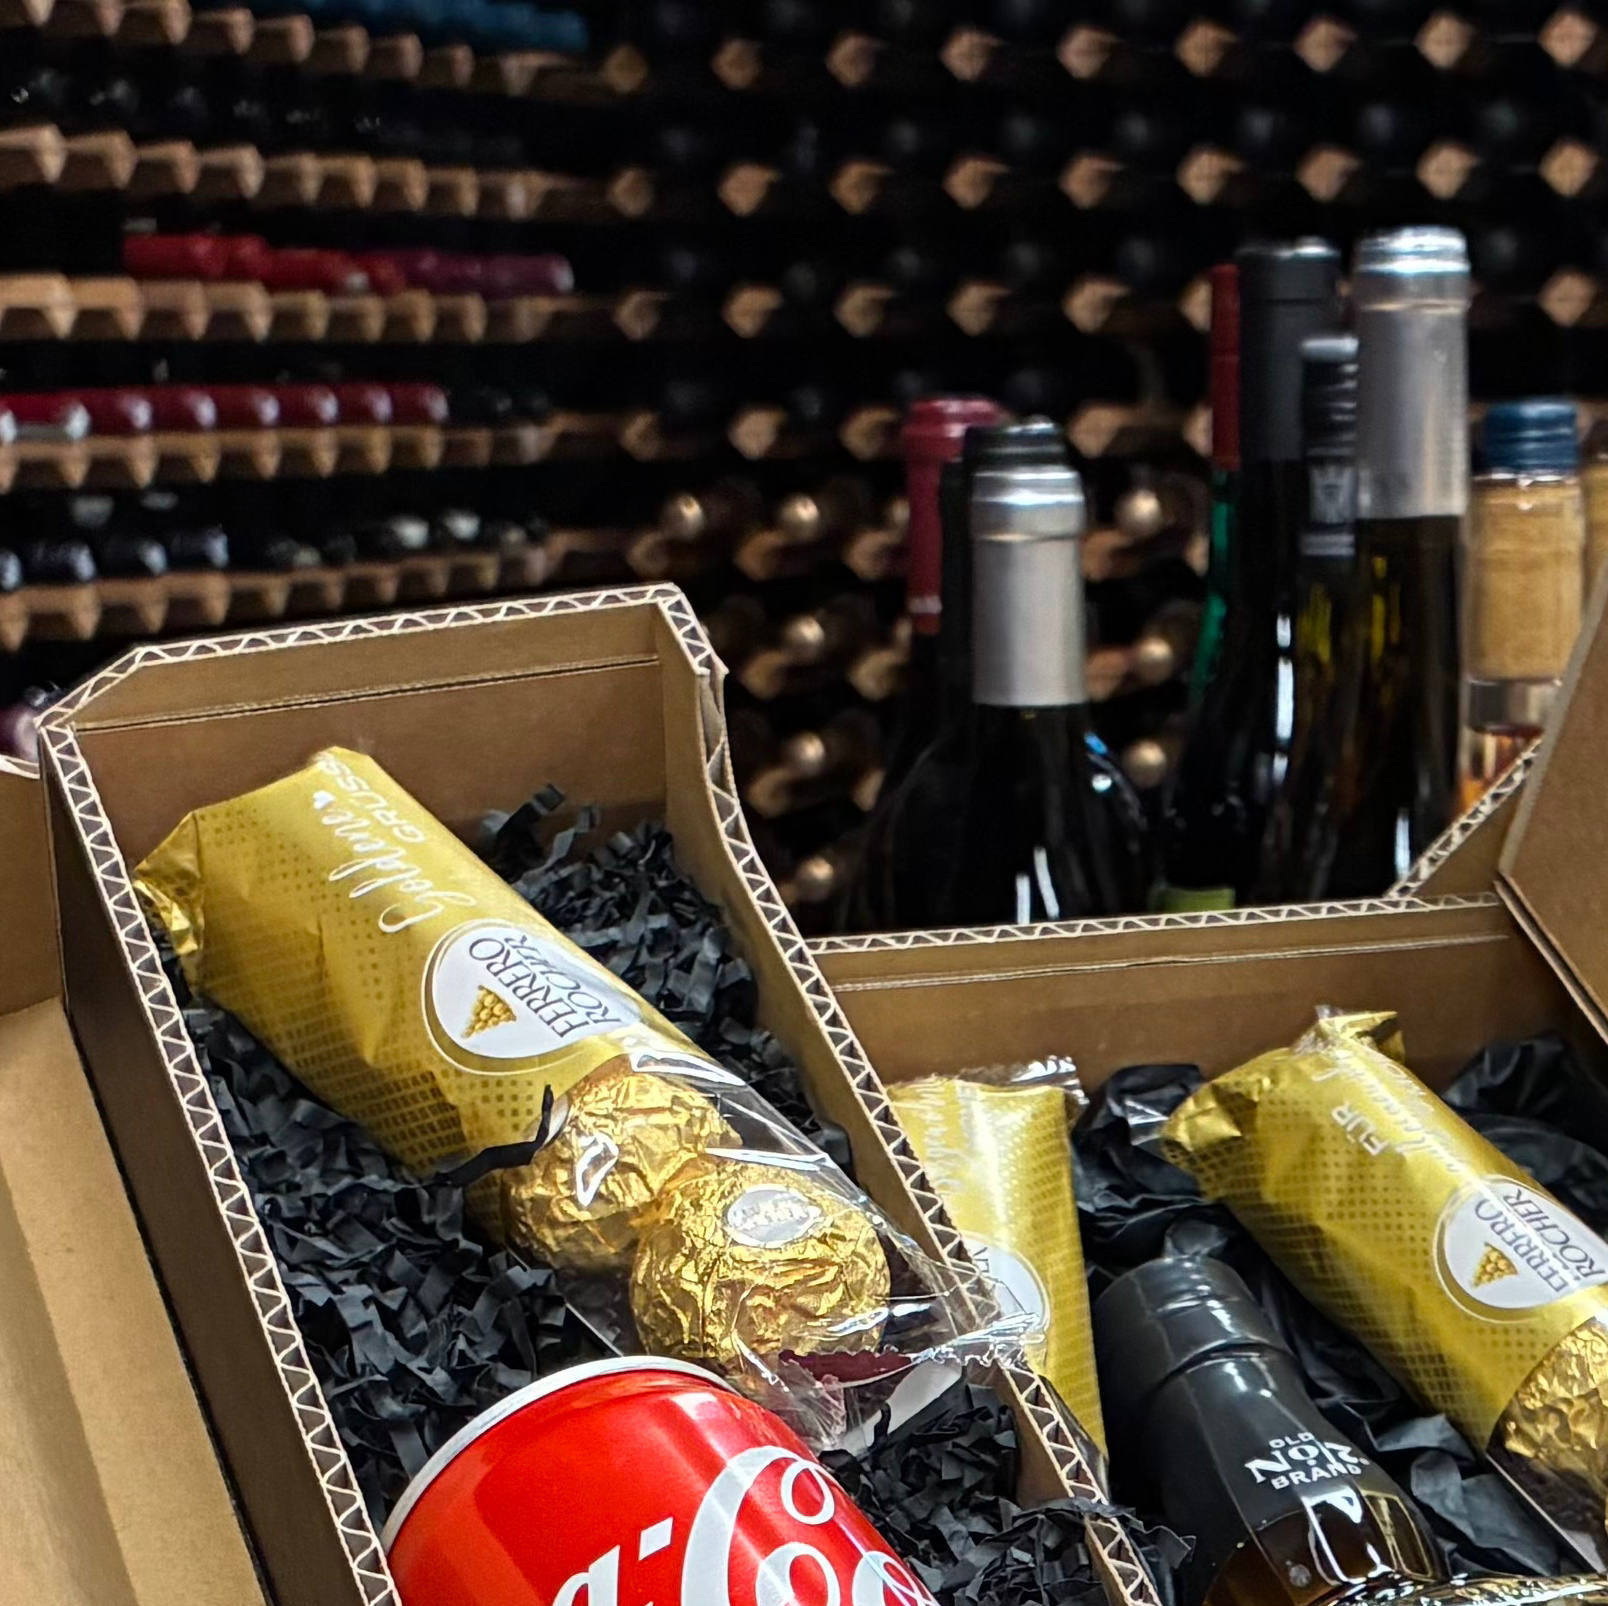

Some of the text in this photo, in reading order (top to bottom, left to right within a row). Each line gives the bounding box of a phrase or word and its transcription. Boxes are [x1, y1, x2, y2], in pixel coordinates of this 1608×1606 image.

[321, 808, 477, 933] Goldene
[468, 937, 590, 1039] FERRERO
[503, 935, 621, 1025] ROCHER
[1332, 1101, 1390, 1156] FÜR
[1503, 1189, 1607, 1278] ROCHER
[1268, 1431, 1315, 1449] OLD
[1270, 1461, 1362, 1490] BRAND
